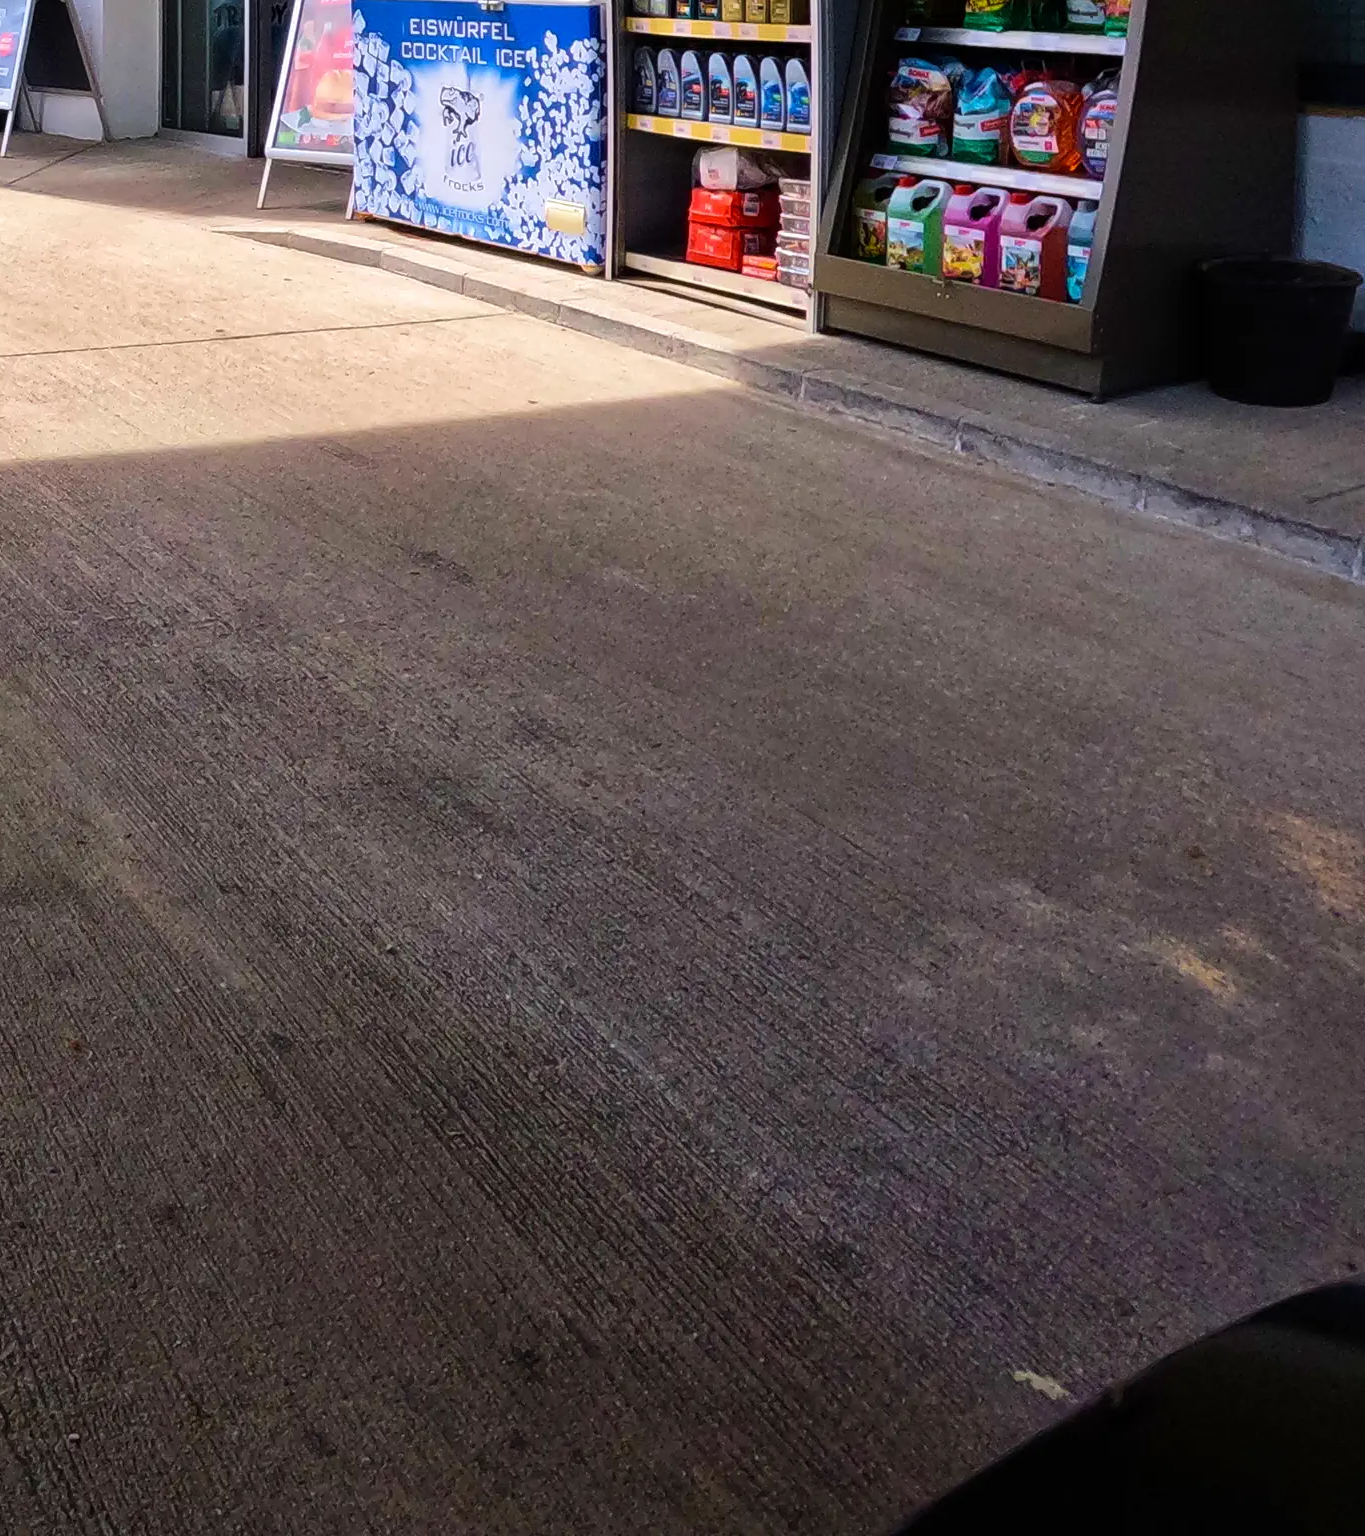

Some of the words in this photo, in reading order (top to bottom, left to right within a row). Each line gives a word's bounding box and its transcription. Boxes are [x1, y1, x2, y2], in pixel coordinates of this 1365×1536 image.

[409, 16, 516, 42] EISWÜRFEL
[401, 42, 484, 66] COCKTAIL
[496, 49, 527, 69] ICE
